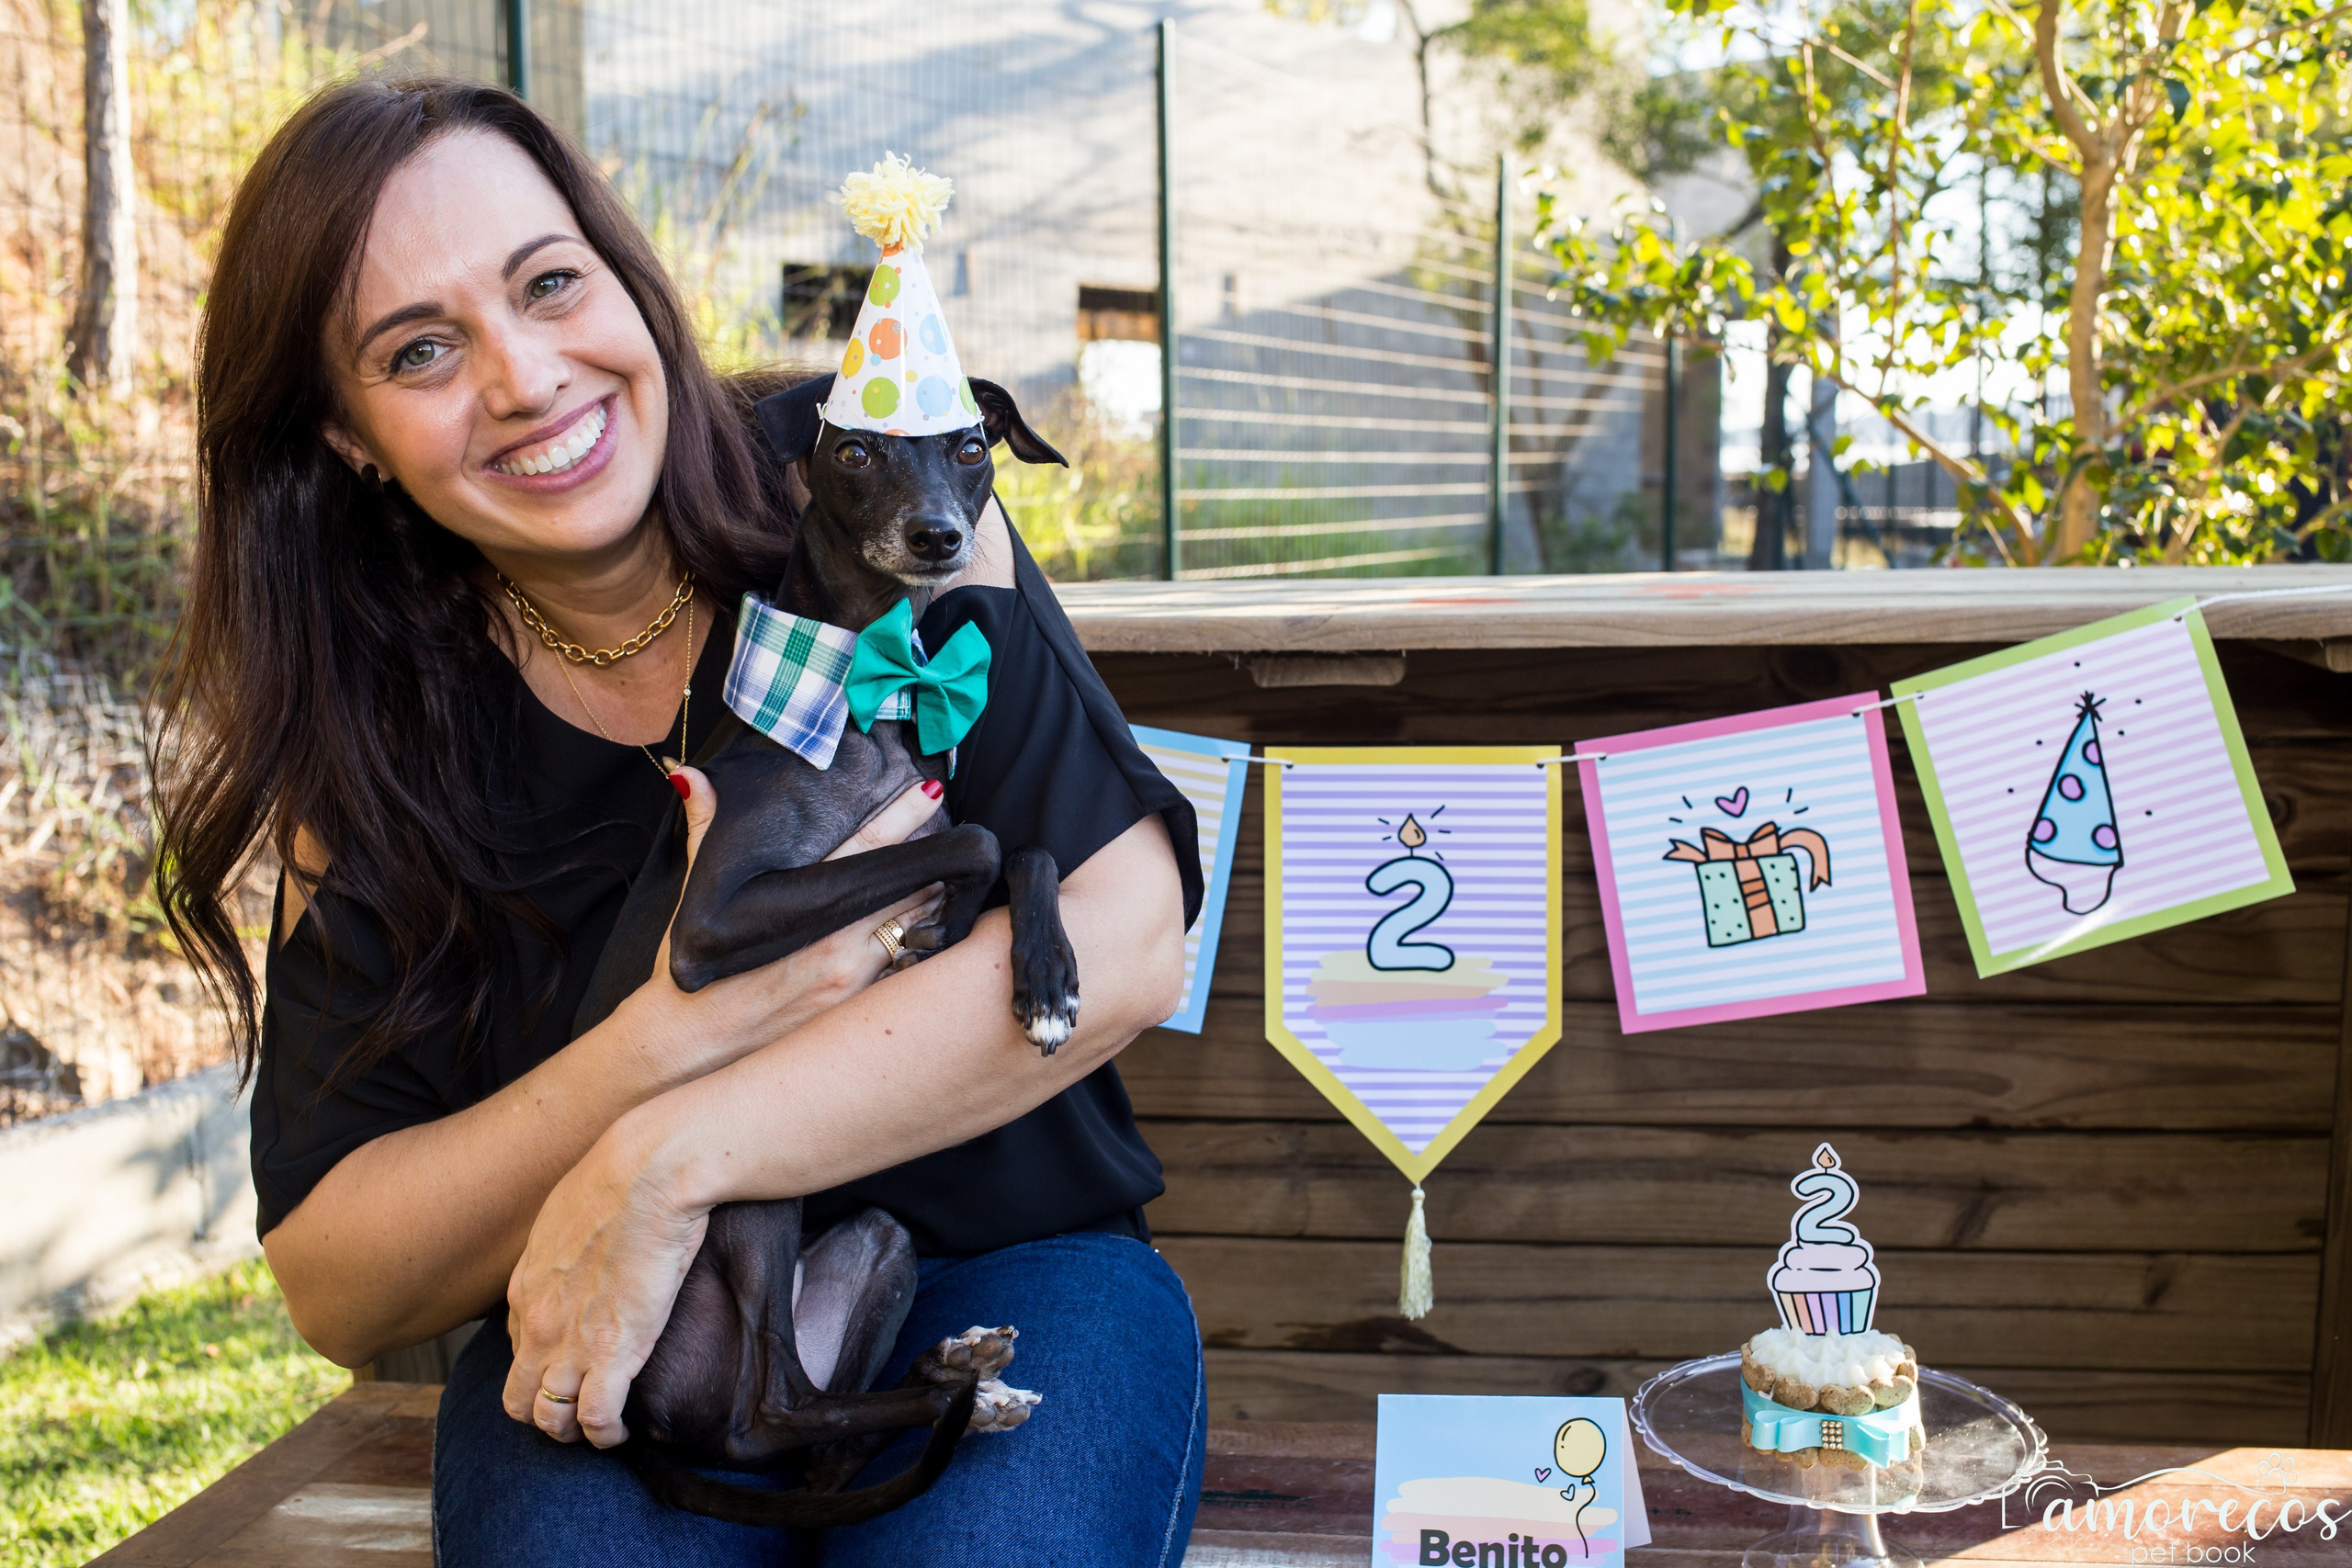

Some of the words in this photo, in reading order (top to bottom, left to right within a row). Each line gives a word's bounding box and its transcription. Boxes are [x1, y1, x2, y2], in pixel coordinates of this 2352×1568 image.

[1365, 855, 1455, 972] 2
[1795, 1172, 1855, 1245] 2
[1419, 1529, 1567, 1568] Benito
